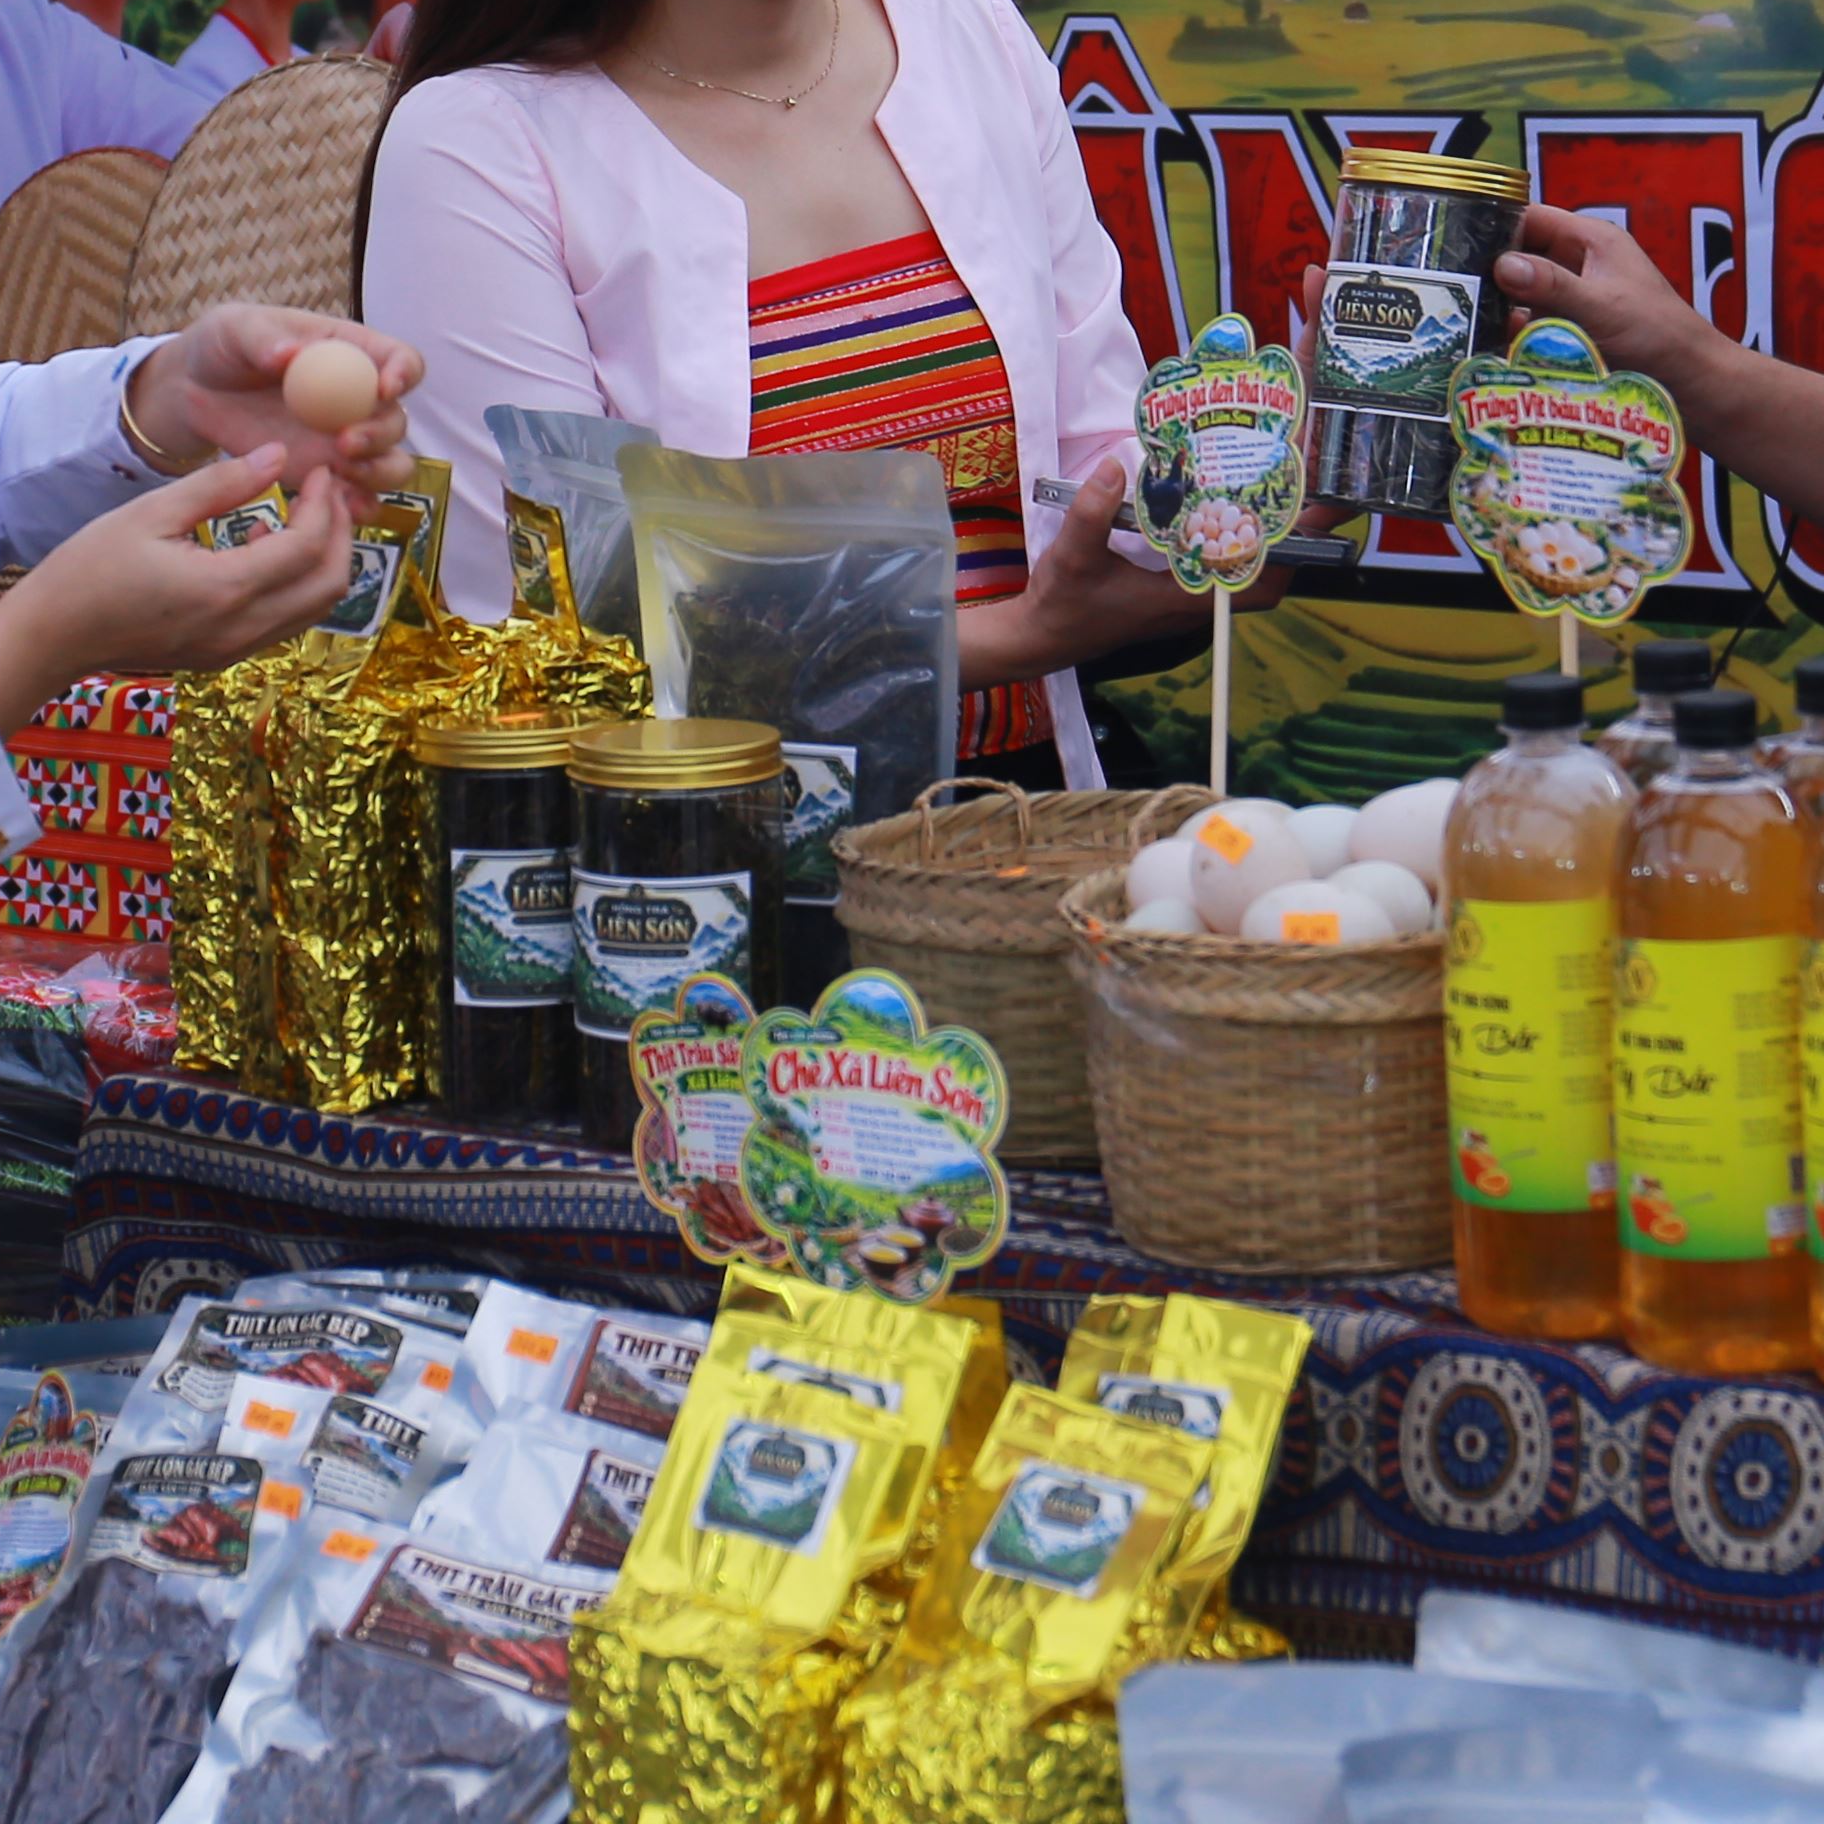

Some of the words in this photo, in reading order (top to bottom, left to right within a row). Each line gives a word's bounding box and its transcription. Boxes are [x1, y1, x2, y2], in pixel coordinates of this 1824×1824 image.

[1336, 295, 1376, 323] LIÊN
[1375, 301, 1417, 328] SƠN
[1458, 388, 1518, 430] Trứng
[596, 913, 641, 942] LIÊN
[645, 915, 691, 942] SƠN
[768, 1049, 822, 1095] Chè
[824, 1049, 864, 1088] Xã
[869, 1052, 924, 1100] Liên
[928, 1065, 987, 1127] Sơn
